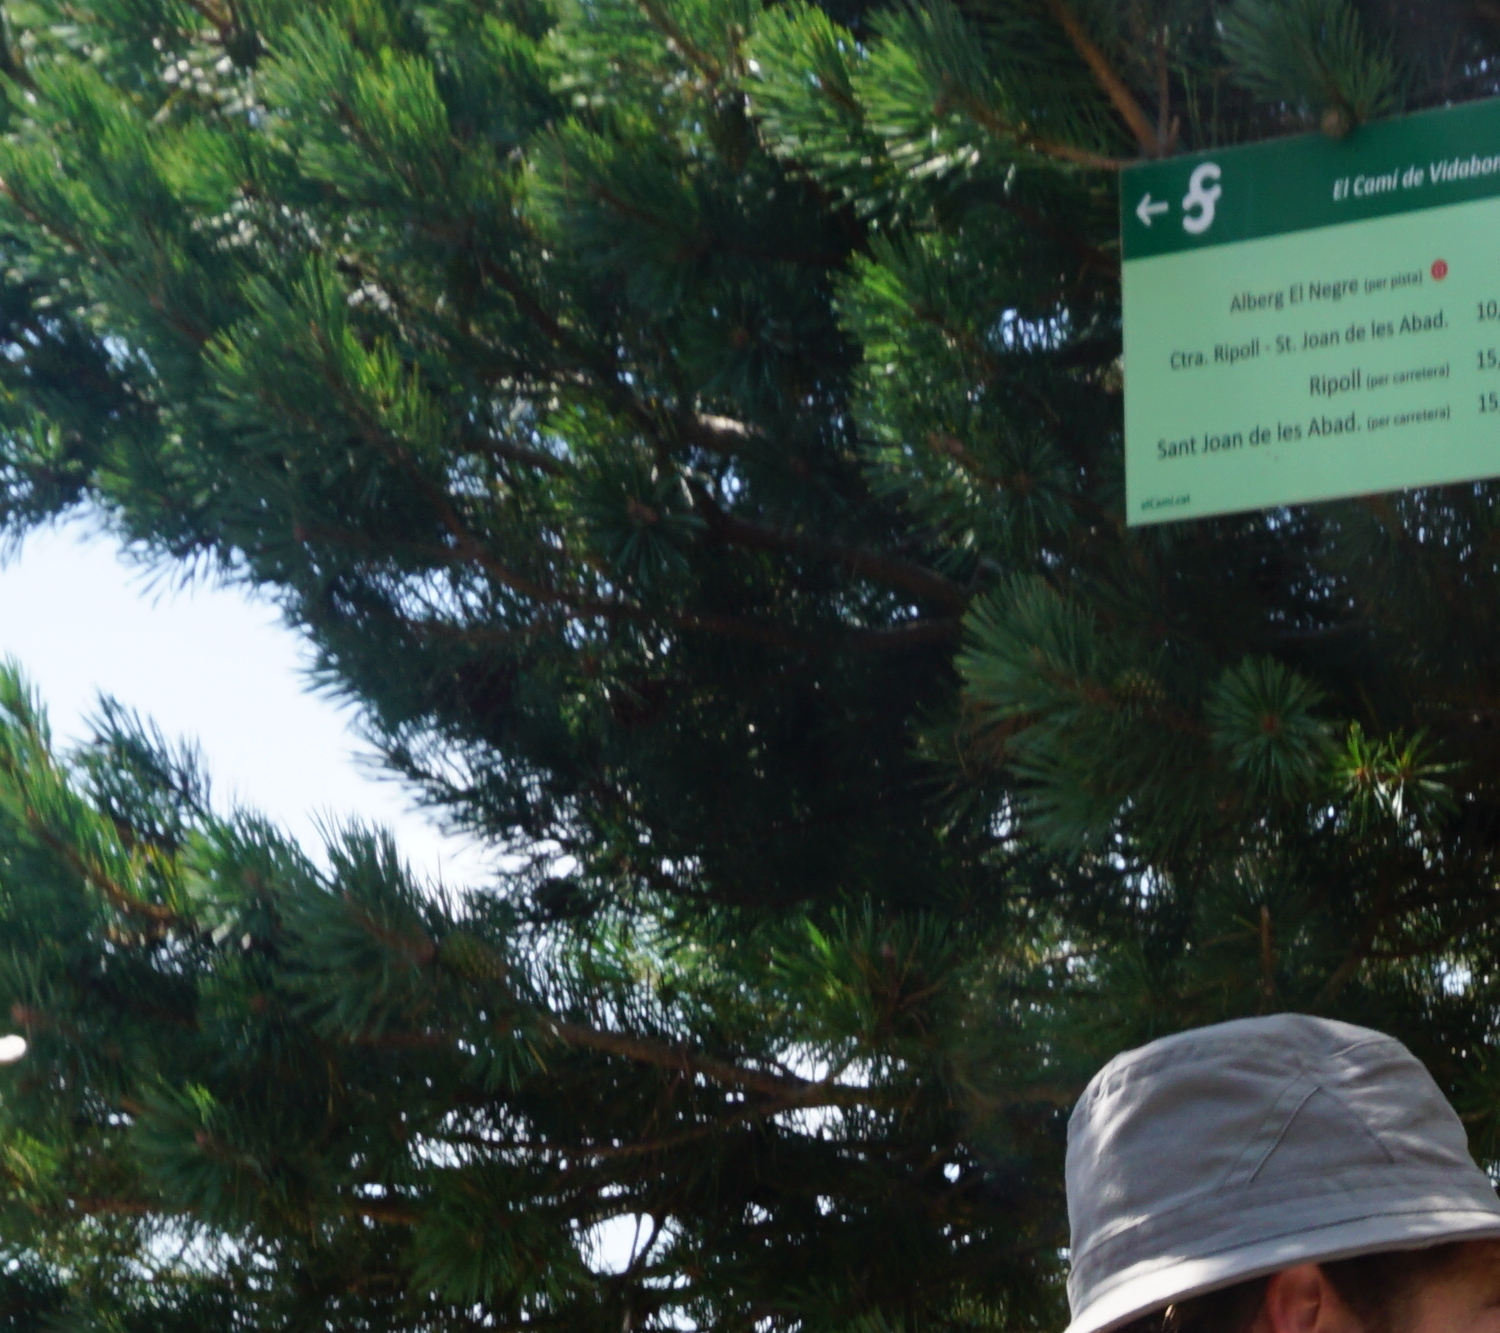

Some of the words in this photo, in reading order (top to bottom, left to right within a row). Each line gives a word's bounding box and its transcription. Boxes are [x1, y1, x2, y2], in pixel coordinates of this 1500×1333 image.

[1332, 177, 1350, 201] El
[1352, 169, 1399, 196] Camí
[1401, 165, 1425, 188] de
[1229, 291, 1285, 313] Alberg
[1288, 282, 1304, 305] El
[1308, 279, 1359, 301] Negre
[1169, 351, 1208, 370] Ctra.
[1213, 338, 1260, 365] Ripoll
[1275, 335, 1296, 354] St.
[1301, 330, 1340, 350] Joan
[1344, 323, 1367, 343] de
[1370, 319, 1395, 339] les
[1398, 309, 1448, 334] Abad.
[1309, 368, 1361, 398] Ripoll
[1157, 436, 1197, 460] Sant
[1201, 432, 1243, 453] Joan
[1247, 424, 1271, 447] de
[1276, 421, 1303, 442] les
[1307, 411, 1361, 437] Abad.
